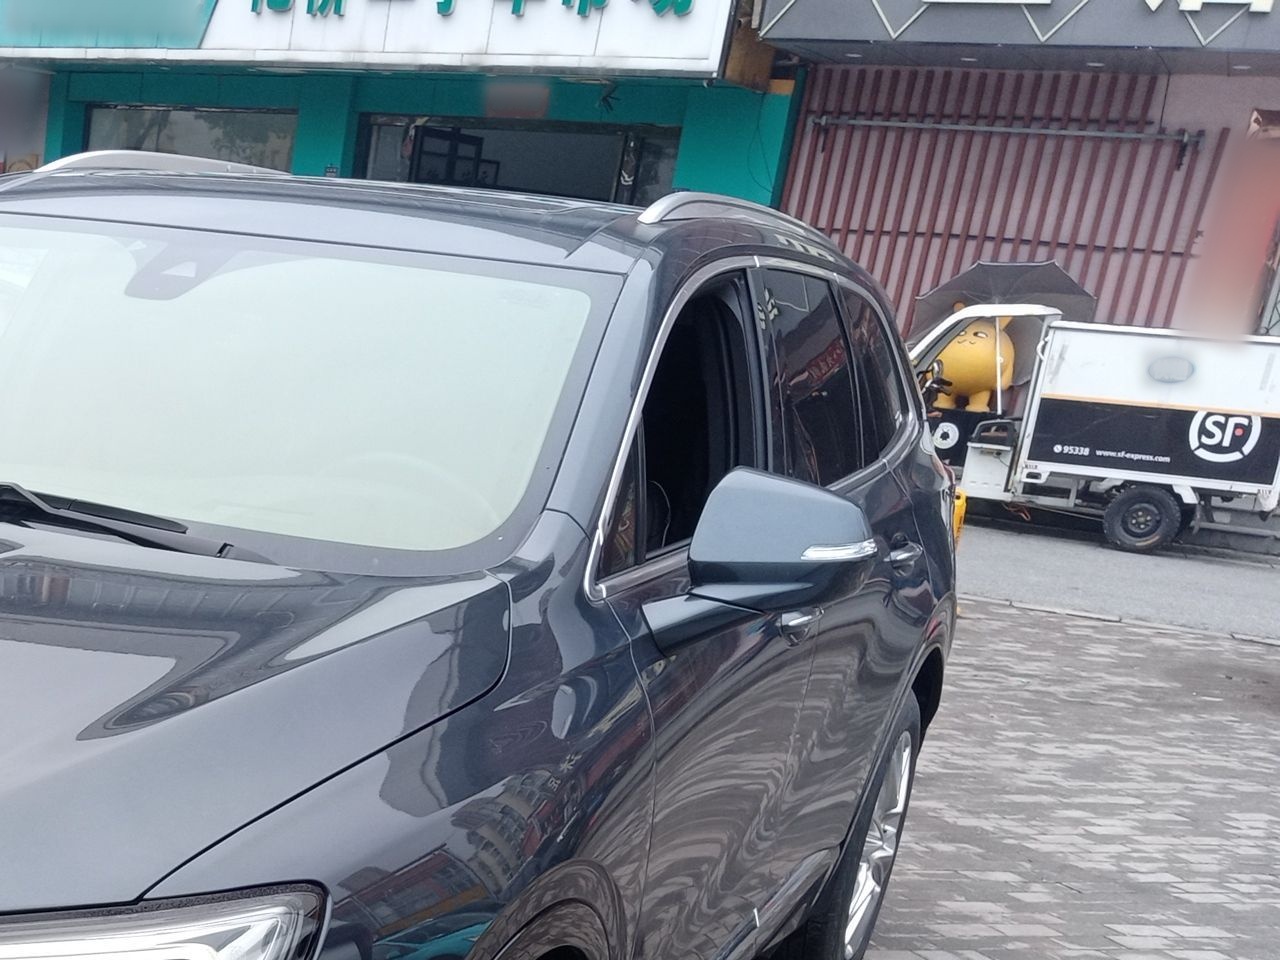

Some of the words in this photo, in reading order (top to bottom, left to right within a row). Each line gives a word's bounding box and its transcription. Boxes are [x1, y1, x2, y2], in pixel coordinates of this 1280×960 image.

[1200, 414, 1249, 448] SF
[1062, 445, 1090, 457] 95338
[1095, 449, 1171, 464] www.sf-express.com
